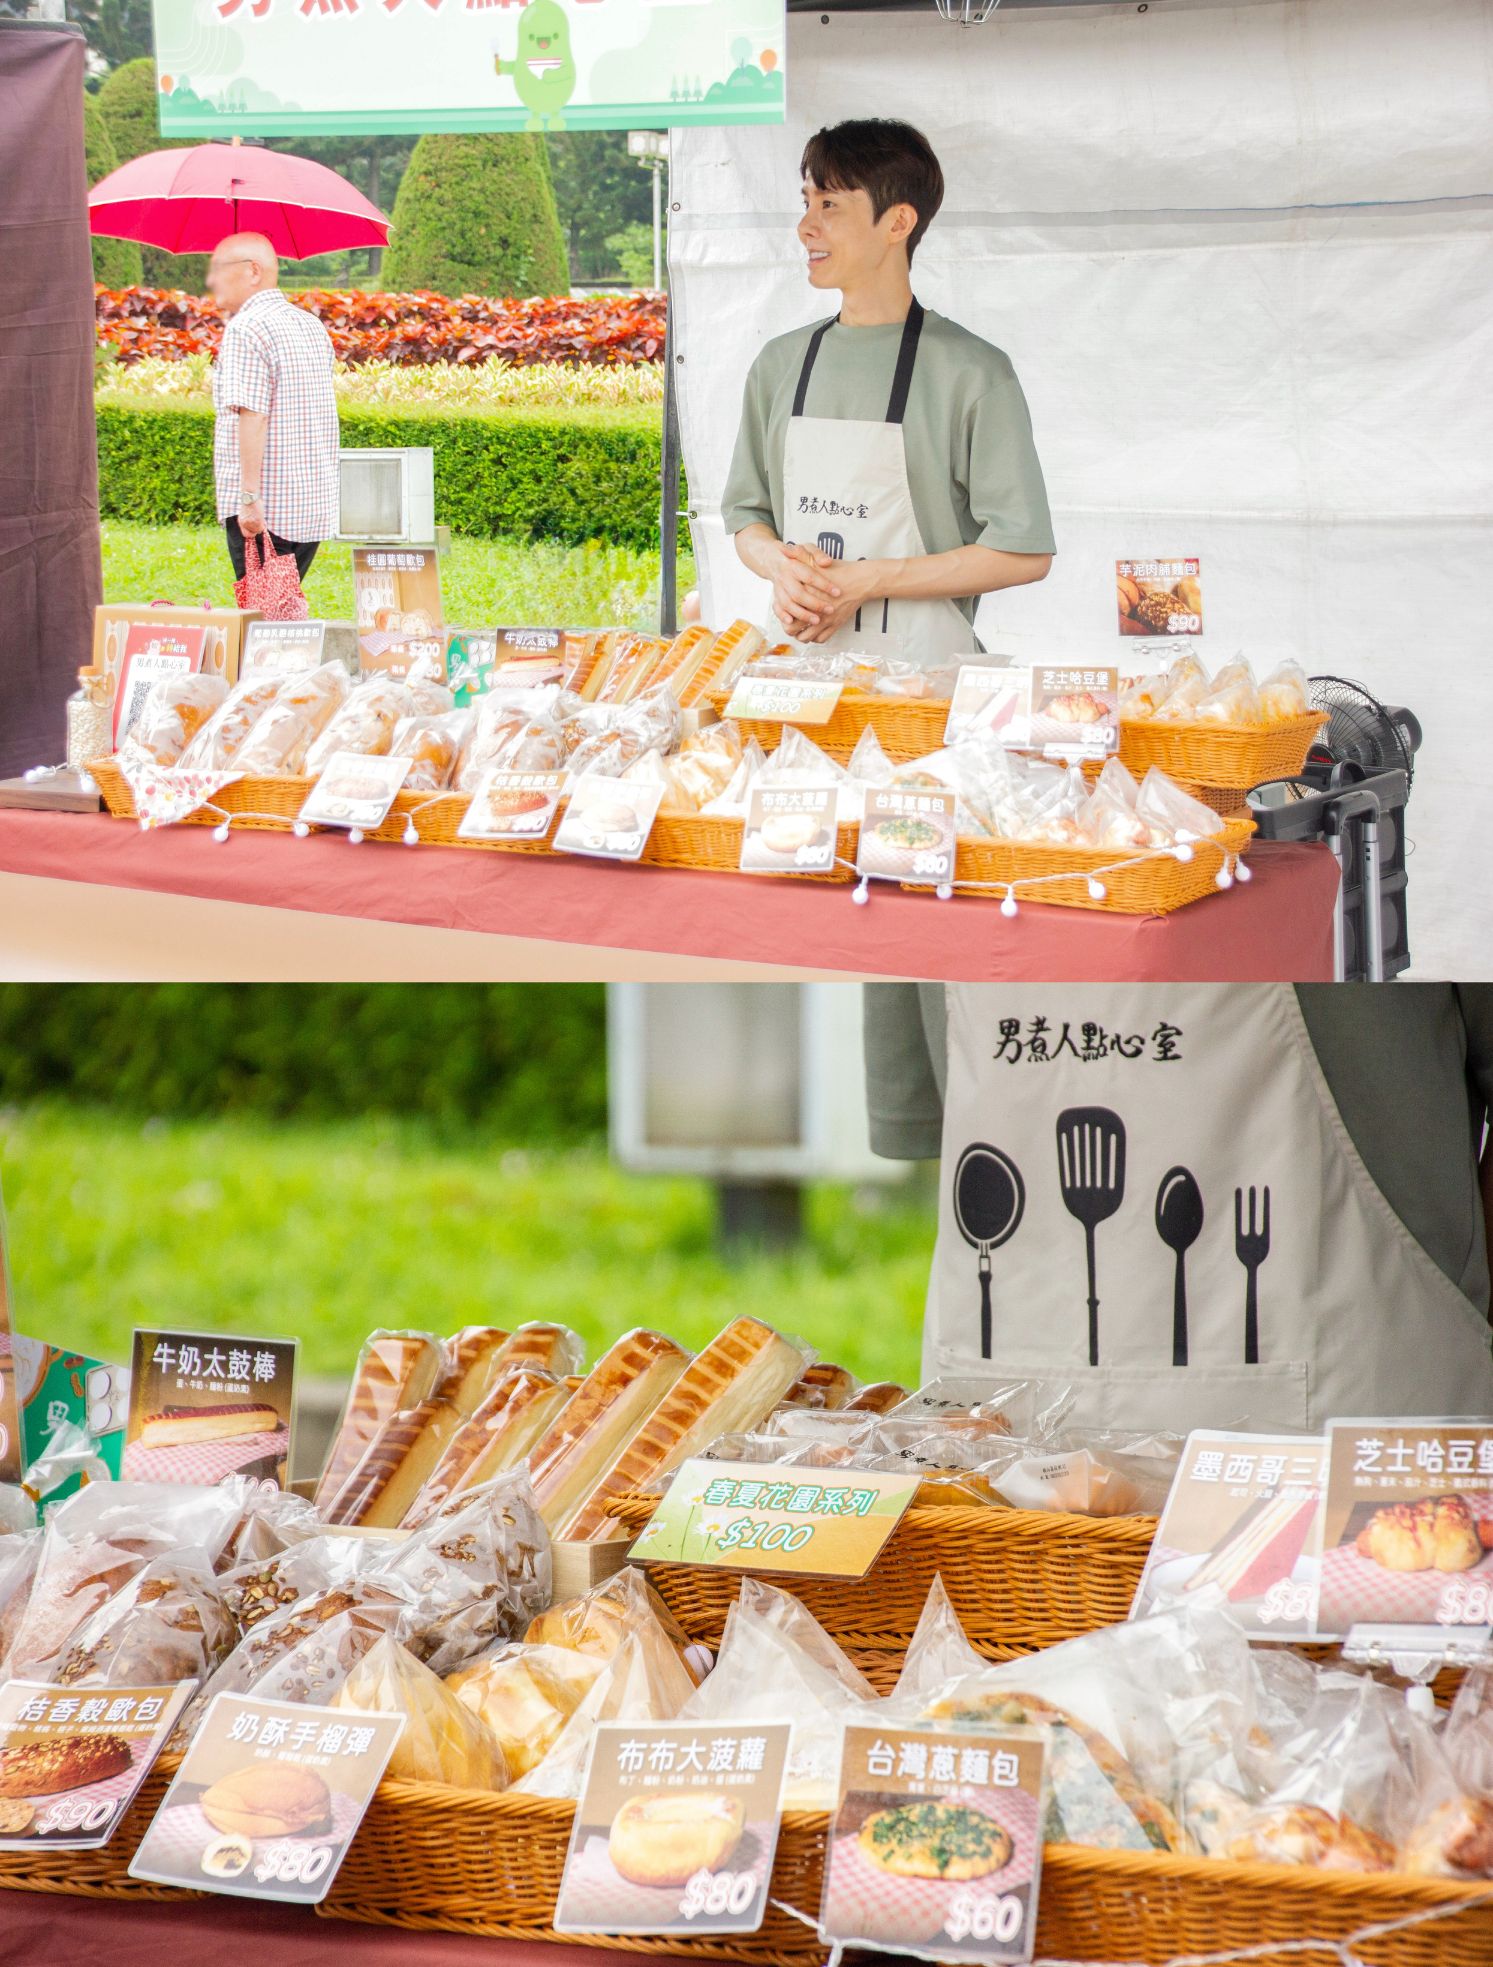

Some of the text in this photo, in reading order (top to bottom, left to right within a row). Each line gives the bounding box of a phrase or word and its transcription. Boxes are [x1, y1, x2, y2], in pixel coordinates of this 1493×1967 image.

[797, 496, 869, 518] 男煮人點心室
[993, 1016, 1183, 1065] 男煮人點心室
[152, 1342, 278, 1383] 牛奶太鼓棒
[704, 1477, 880, 1516] 春夏花園系列
[715, 1516, 815, 1552] $100
[227, 1711, 376, 1757] 奶酥手榴彈
[35, 1799, 119, 1834] $90
[254, 1839, 333, 1884] $80
[679, 1867, 758, 1920] $80
[944, 1892, 1024, 1943] $60
